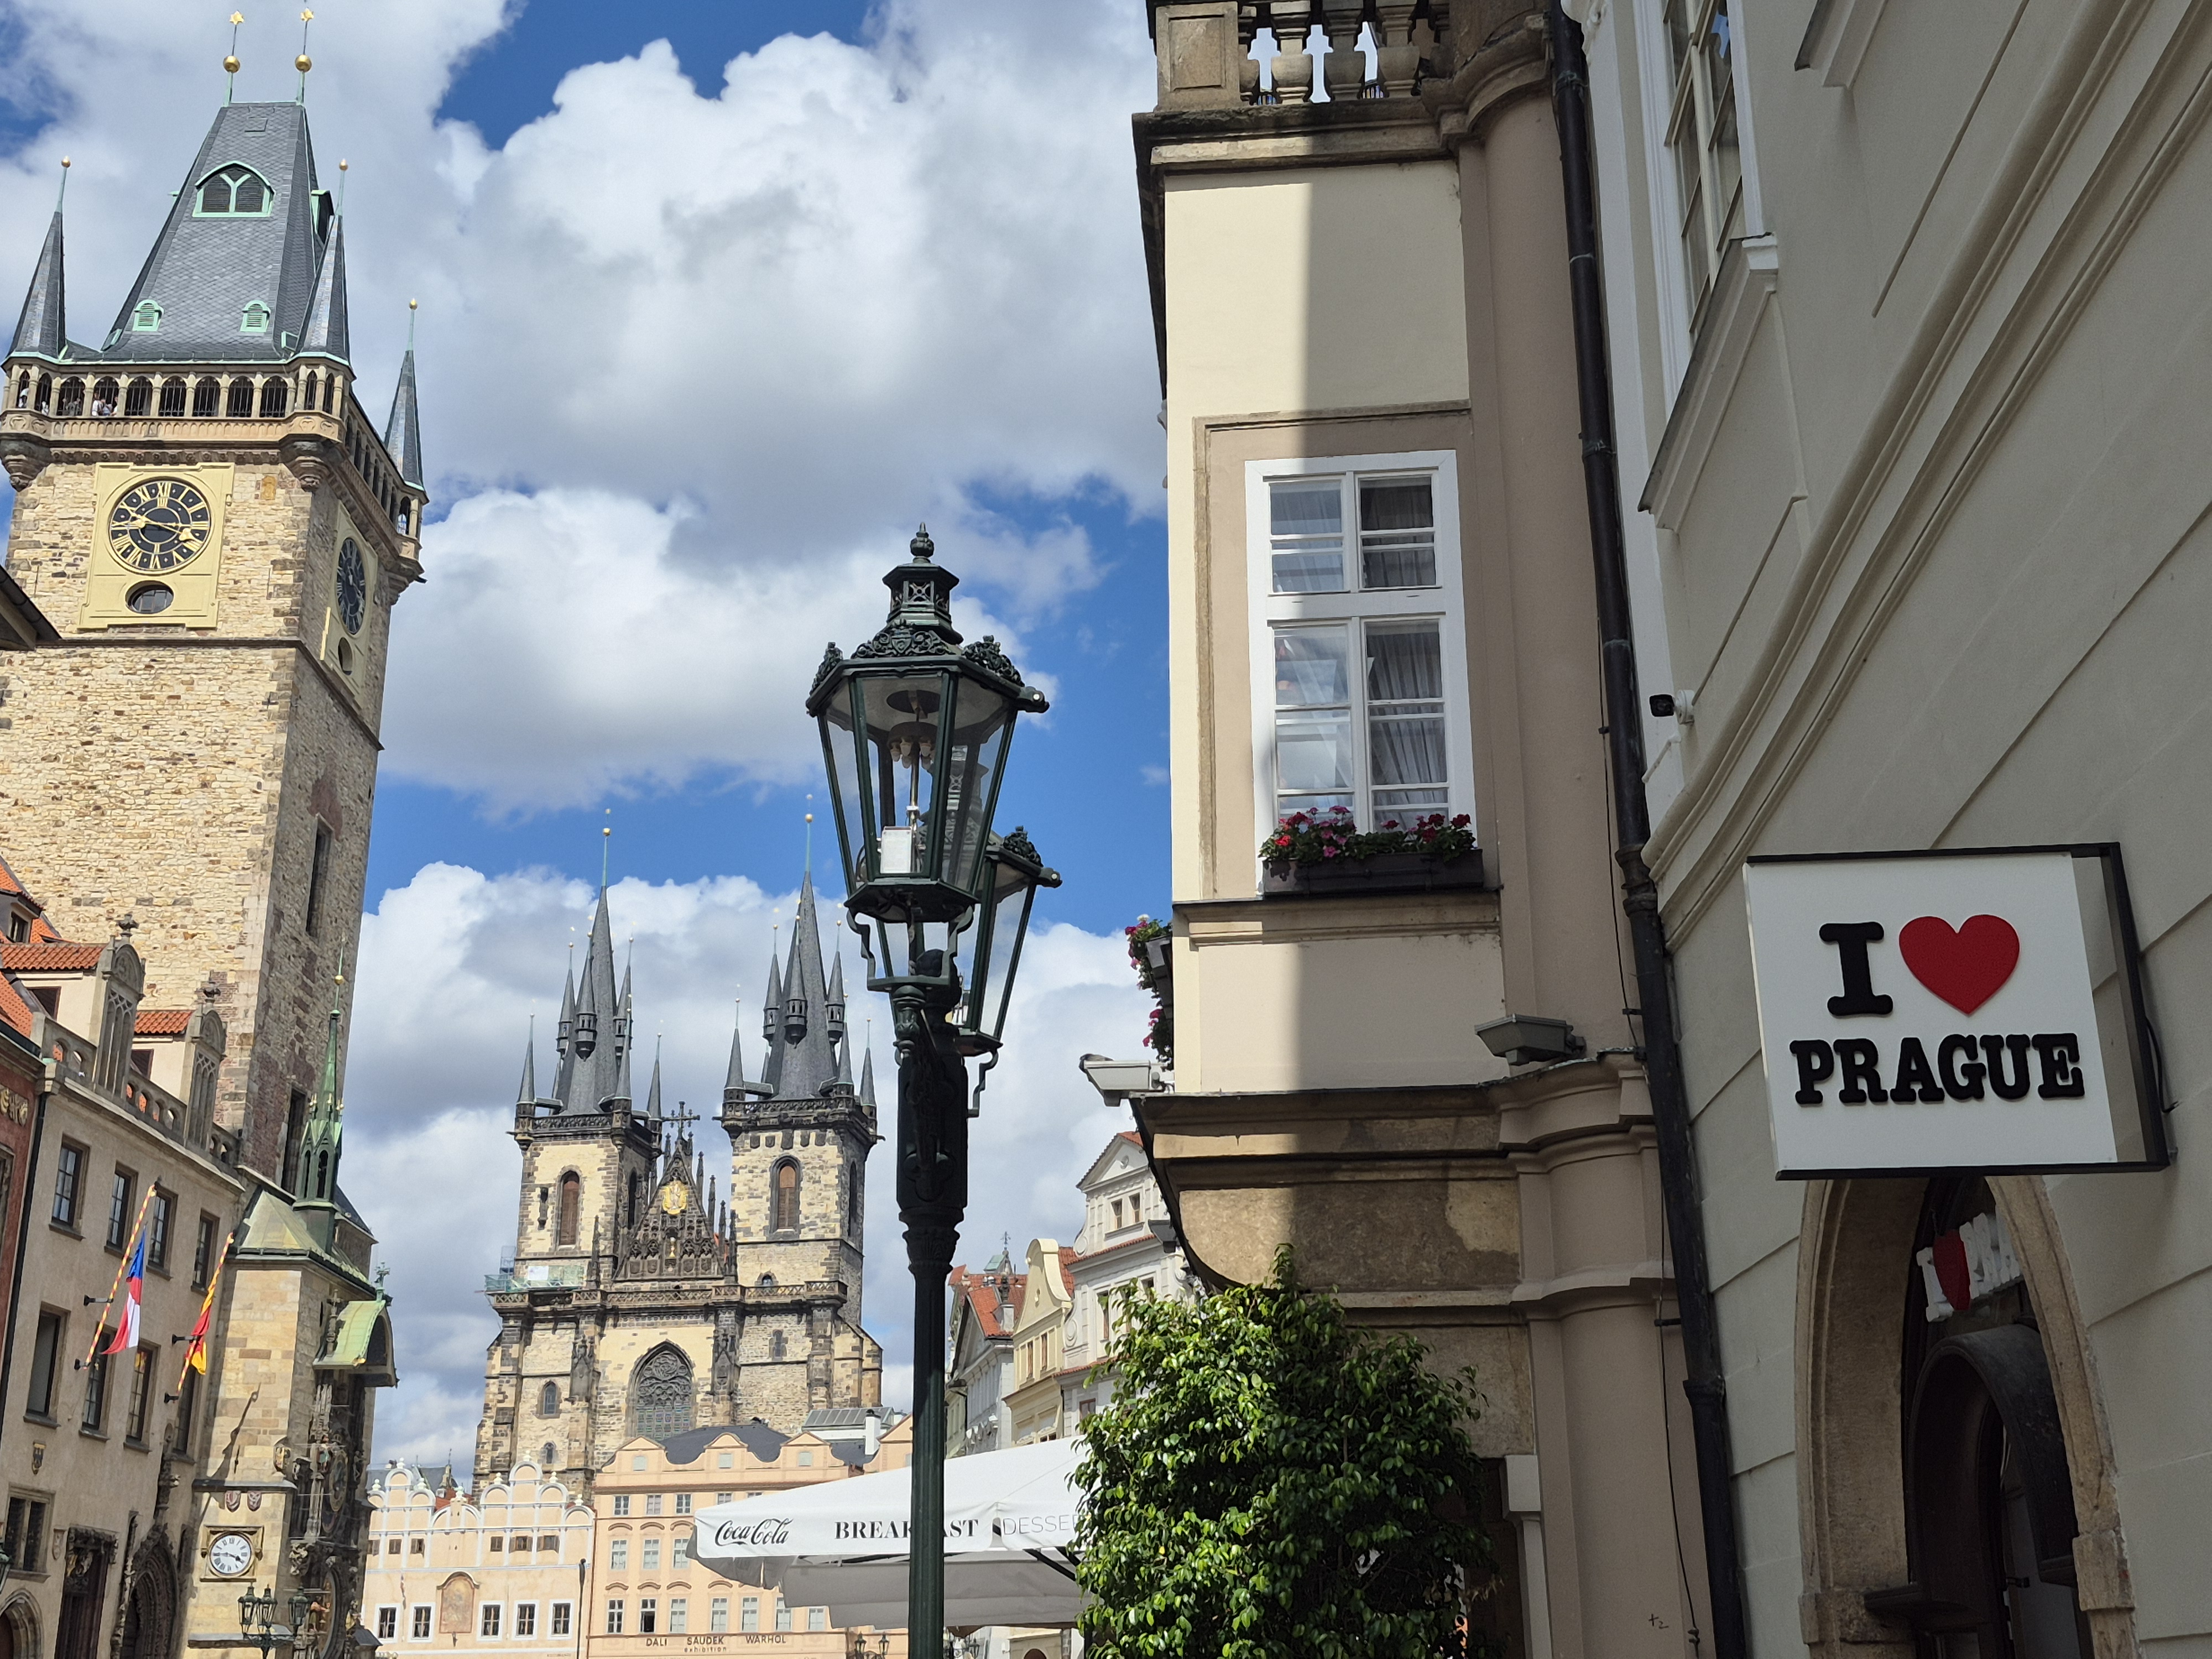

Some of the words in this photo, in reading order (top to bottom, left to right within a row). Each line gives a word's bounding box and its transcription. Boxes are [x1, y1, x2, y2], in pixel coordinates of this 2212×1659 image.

[1819, 921, 1893, 1016] I
[1790, 1032, 2085, 1105] PRAGUE
[715, 1519, 794, 1546] Coca-Cola
[834, 1519, 979, 1539] BREAKST
[646, 1637, 667, 1647] DALI
[686, 1636, 724, 1646] SAUDEK
[746, 1635, 786, 1644] WARHOL
